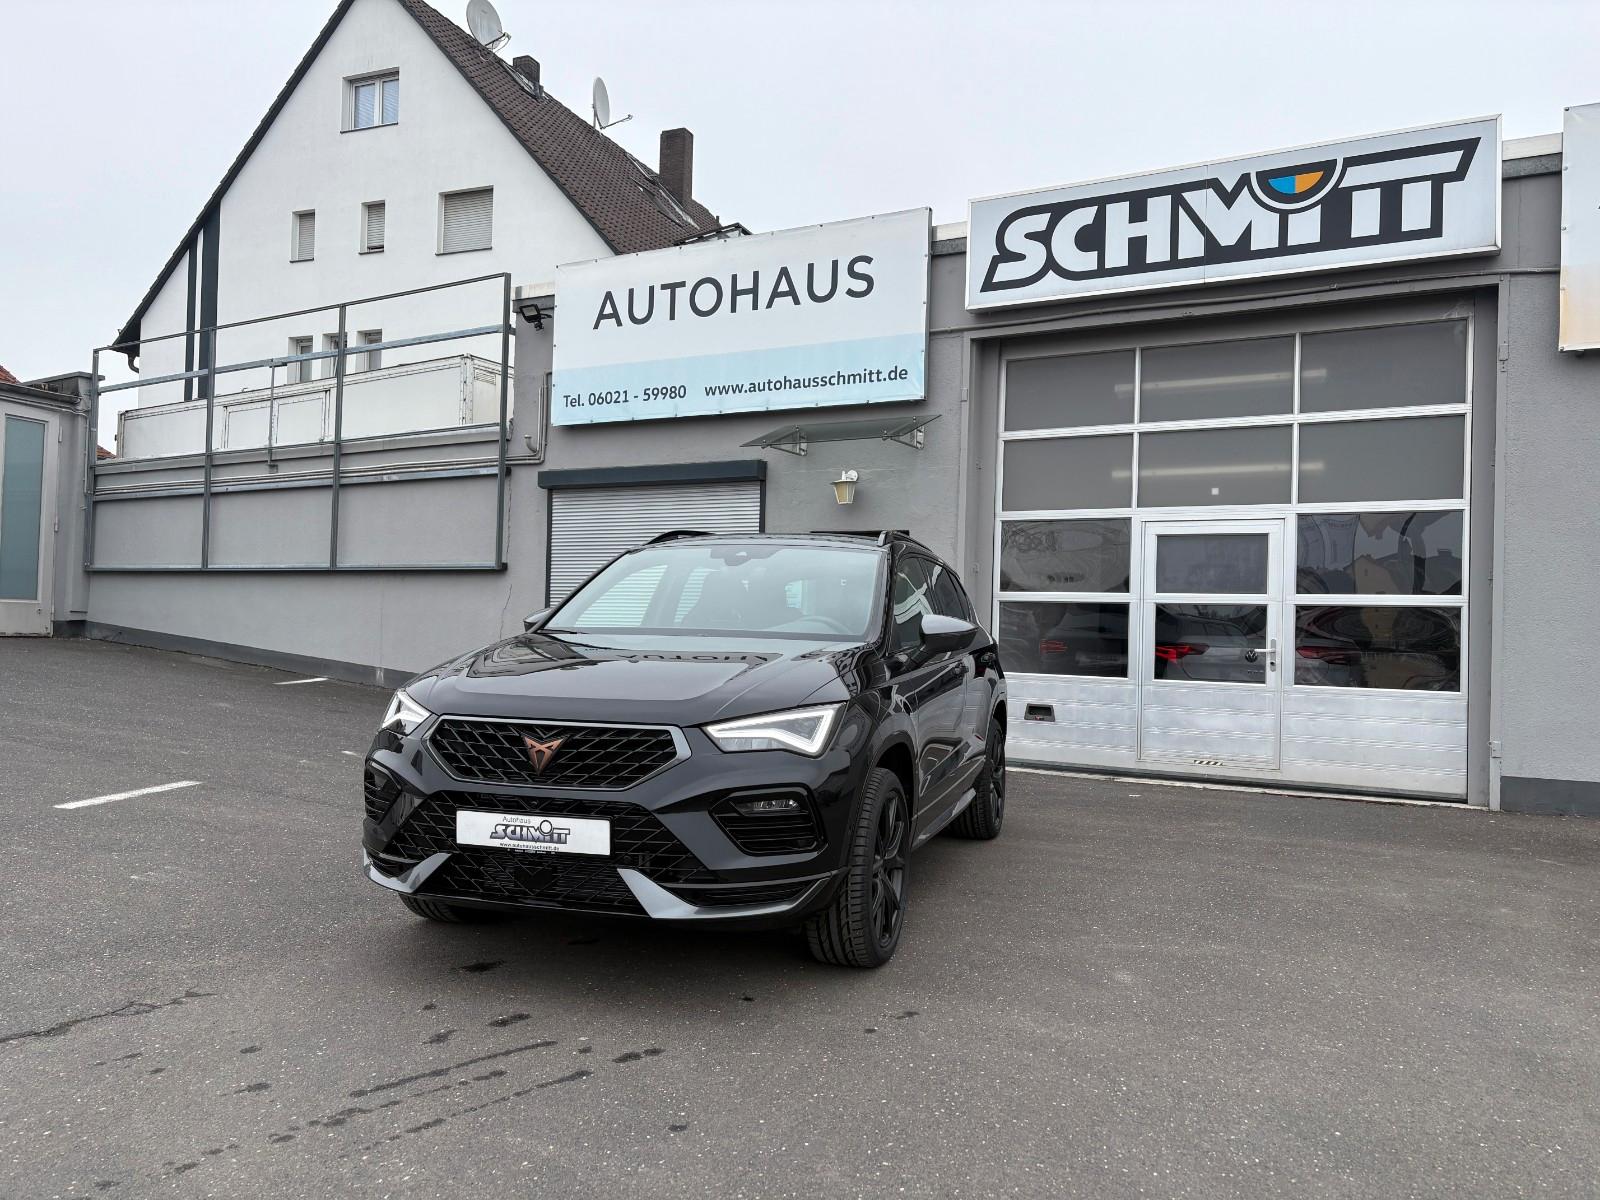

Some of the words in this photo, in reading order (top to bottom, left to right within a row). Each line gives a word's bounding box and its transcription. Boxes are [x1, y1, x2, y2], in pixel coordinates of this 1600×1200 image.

[980, 137, 1482, 293] SCHMITT
[593, 255, 875, 330] AUTOHAUS
[563, 394, 585, 408] Tel.
[588, 390, 629, 406] 06021
[643, 385, 687, 402] 59980
[704, 366, 908, 396] www.autohausschmitt.de
[489, 820, 570, 845] SCHMITT
[502, 816, 531, 824] Autohaus
